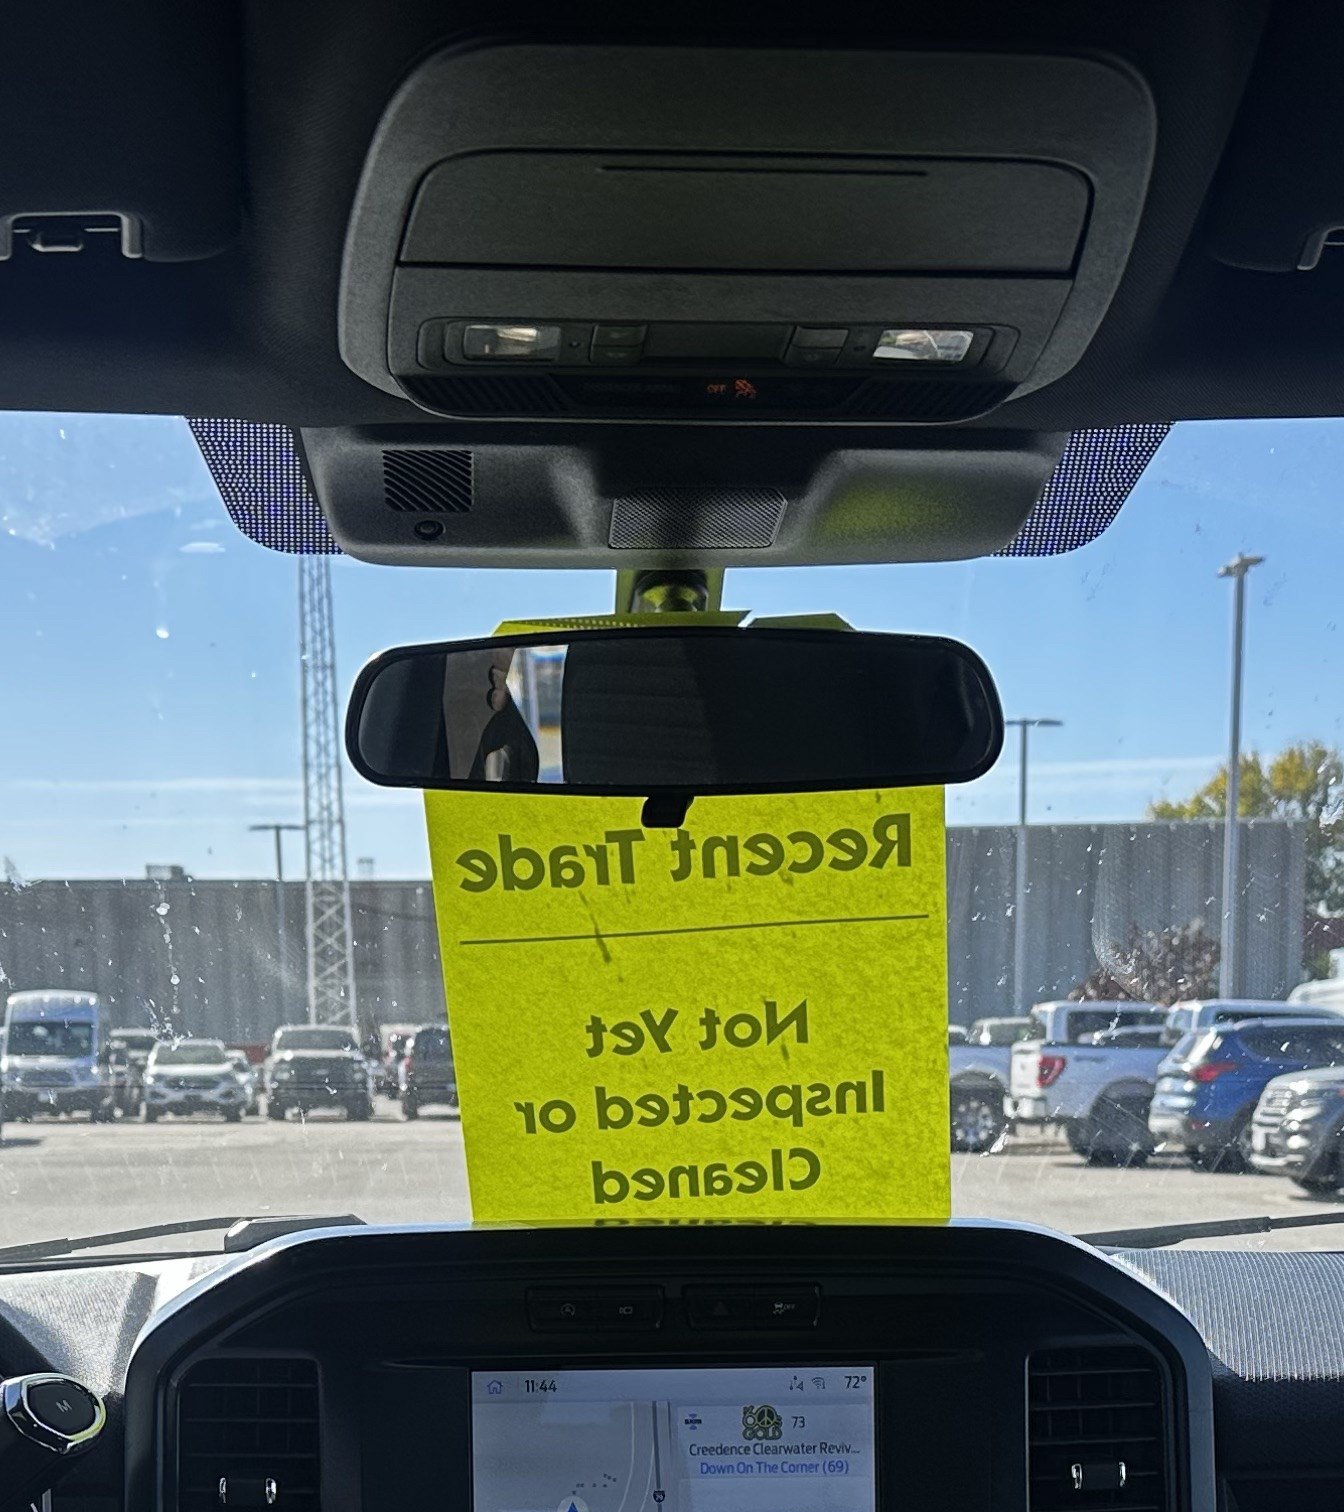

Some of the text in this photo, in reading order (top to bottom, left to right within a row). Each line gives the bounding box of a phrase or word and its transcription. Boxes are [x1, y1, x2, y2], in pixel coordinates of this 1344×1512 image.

[524, 1375, 868, 1394] 11:44 72°
[56, 1400, 73, 1413] M
[790, 1416, 806, 1429] 73
[689, 1443, 751, 1456] Creedence
[752, 1442, 817, 1456] Clearwater
[700, 1459, 850, 1476] Down On The Corner (69)
